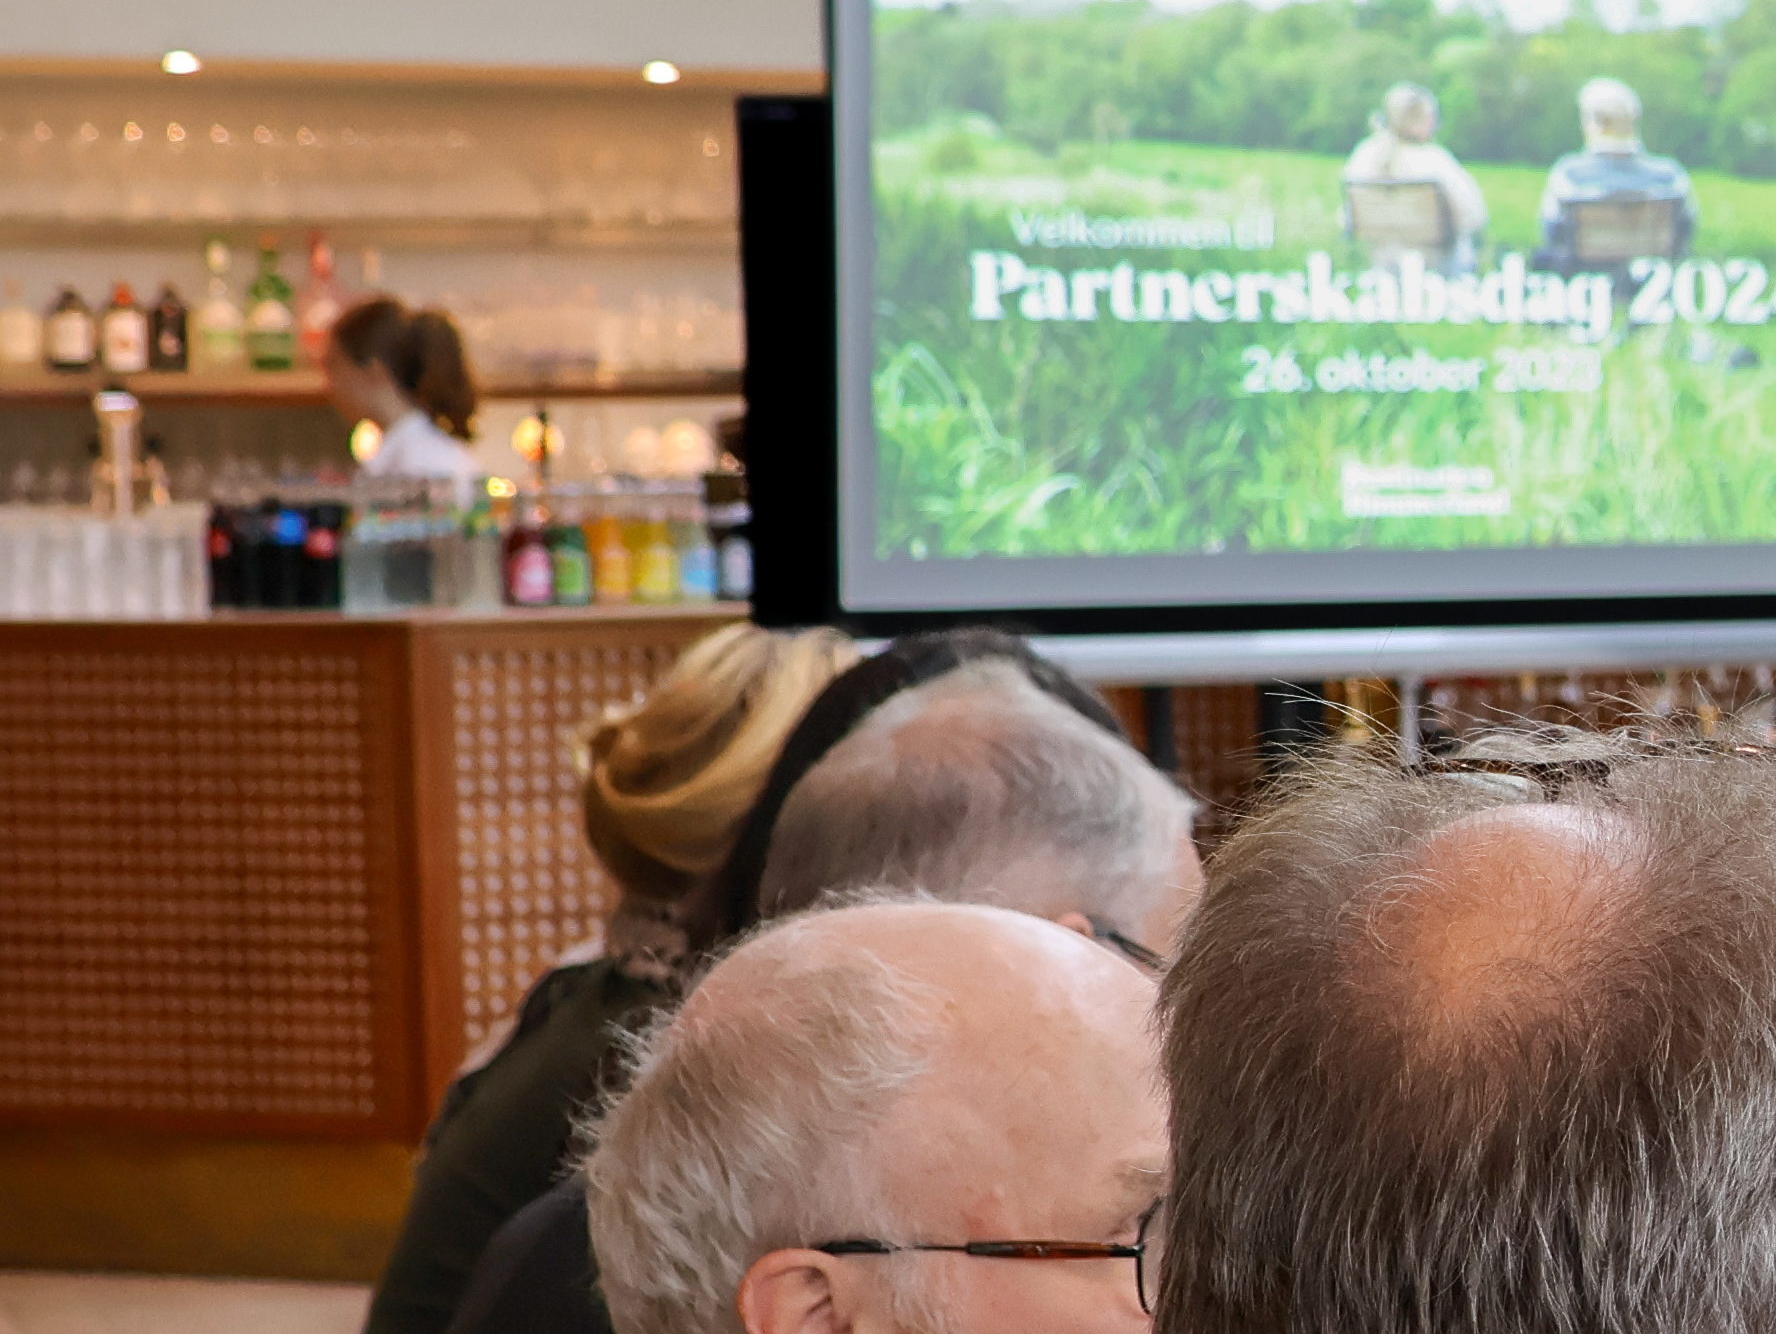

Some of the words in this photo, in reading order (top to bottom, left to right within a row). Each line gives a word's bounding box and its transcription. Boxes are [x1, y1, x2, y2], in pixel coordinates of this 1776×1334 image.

[1010, 210, 1231, 248] Velkommen
[970, 250, 1613, 343] Partnerskabsdag
[1315, 348, 1486, 393] oktober
